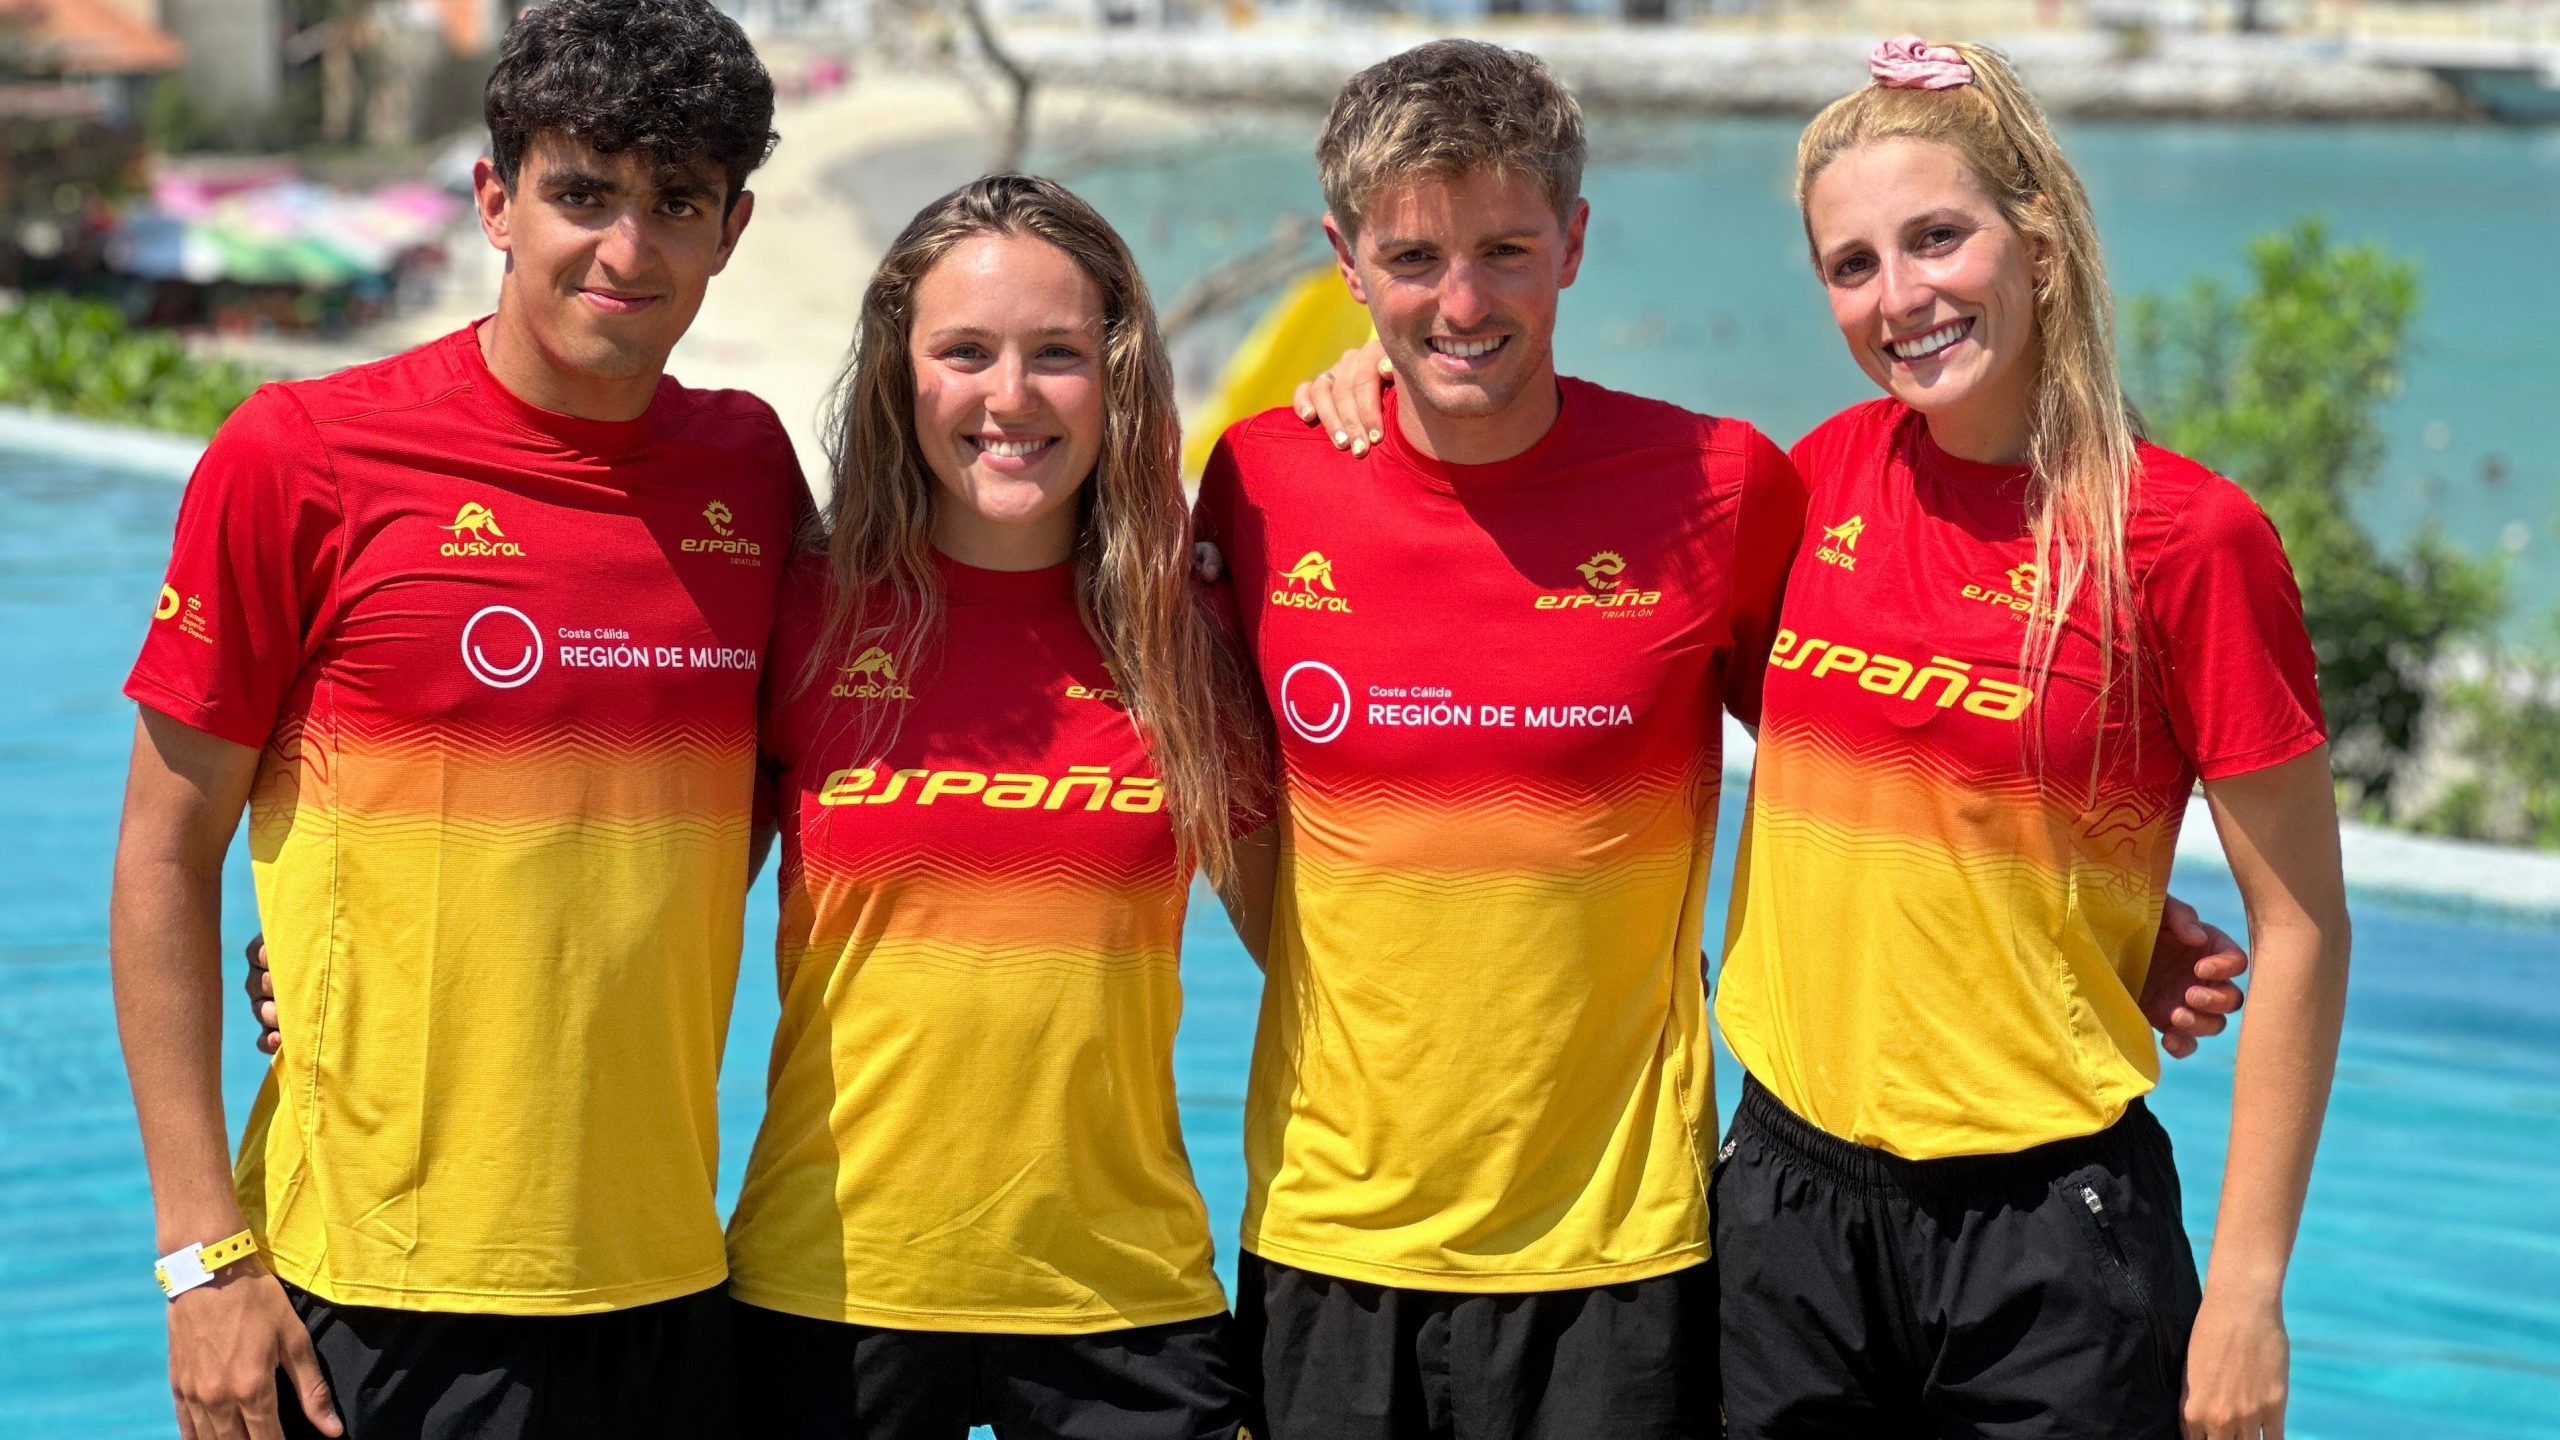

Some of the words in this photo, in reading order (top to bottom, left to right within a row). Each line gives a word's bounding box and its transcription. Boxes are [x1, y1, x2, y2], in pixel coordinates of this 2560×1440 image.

[440, 540, 526, 557] austral
[681, 538, 760, 556] españa
[1271, 590, 1352, 613] austral
[1534, 588, 1661, 609] españa
[1602, 608, 1653, 619] TRIATLÓN
[558, 628, 591, 639] Costa
[594, 627, 629, 639] Cálida
[560, 643, 649, 668] REGIÓN
[655, 647, 683, 668] DE
[690, 647, 756, 670] MURCIA
[1769, 629, 2034, 720] españa
[831, 683, 915, 699] austral
[1369, 686, 1406, 697] Costa
[1411, 686, 1451, 698] Cálida
[1369, 701, 1471, 726] REGIÓN
[1480, 706, 1515, 727] DE
[1525, 705, 1633, 727] MURCIA
[818, 766, 1165, 813] españa
